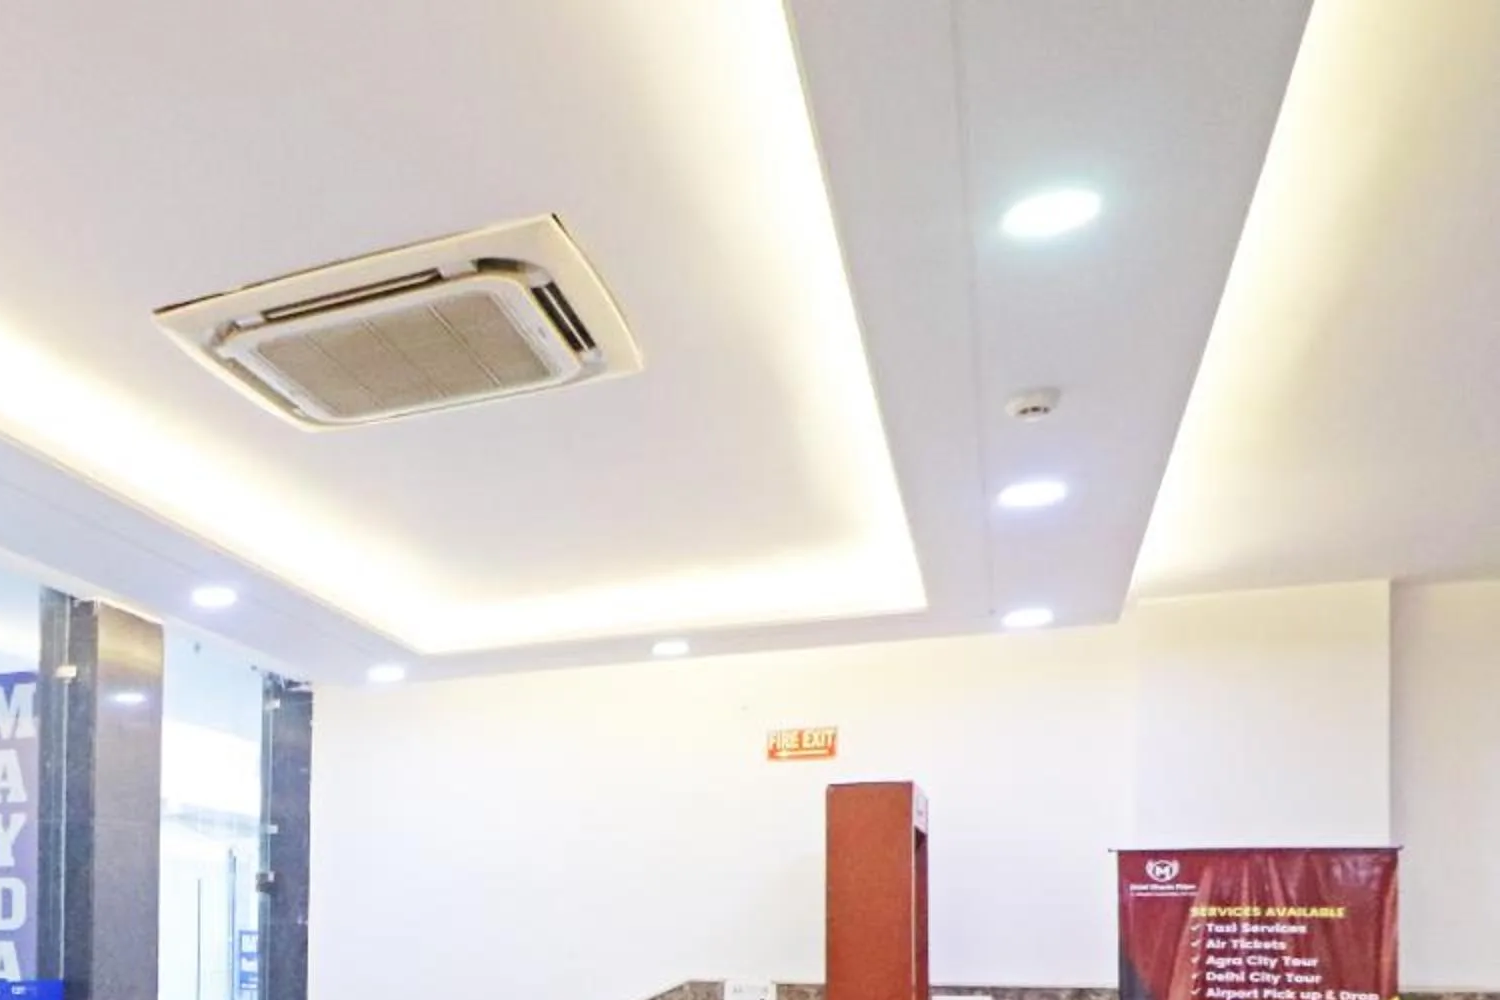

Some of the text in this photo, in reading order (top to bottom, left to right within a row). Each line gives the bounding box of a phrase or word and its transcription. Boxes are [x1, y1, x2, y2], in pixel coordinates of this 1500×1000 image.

[802, 728, 836, 747] EXIT
[1190, 906, 1345, 917] SERVICES AVAILABLE
[1206, 922, 1307, 934] Taxi Services
[1206, 939, 1287, 951] Air Tickets
[1206, 955, 1319, 969] Agra City Tour
[1206, 971, 1322, 985] Delhi City Tour
[1206, 987, 1259, 1000] Airport
[1263, 989, 1296, 1000] Pick
